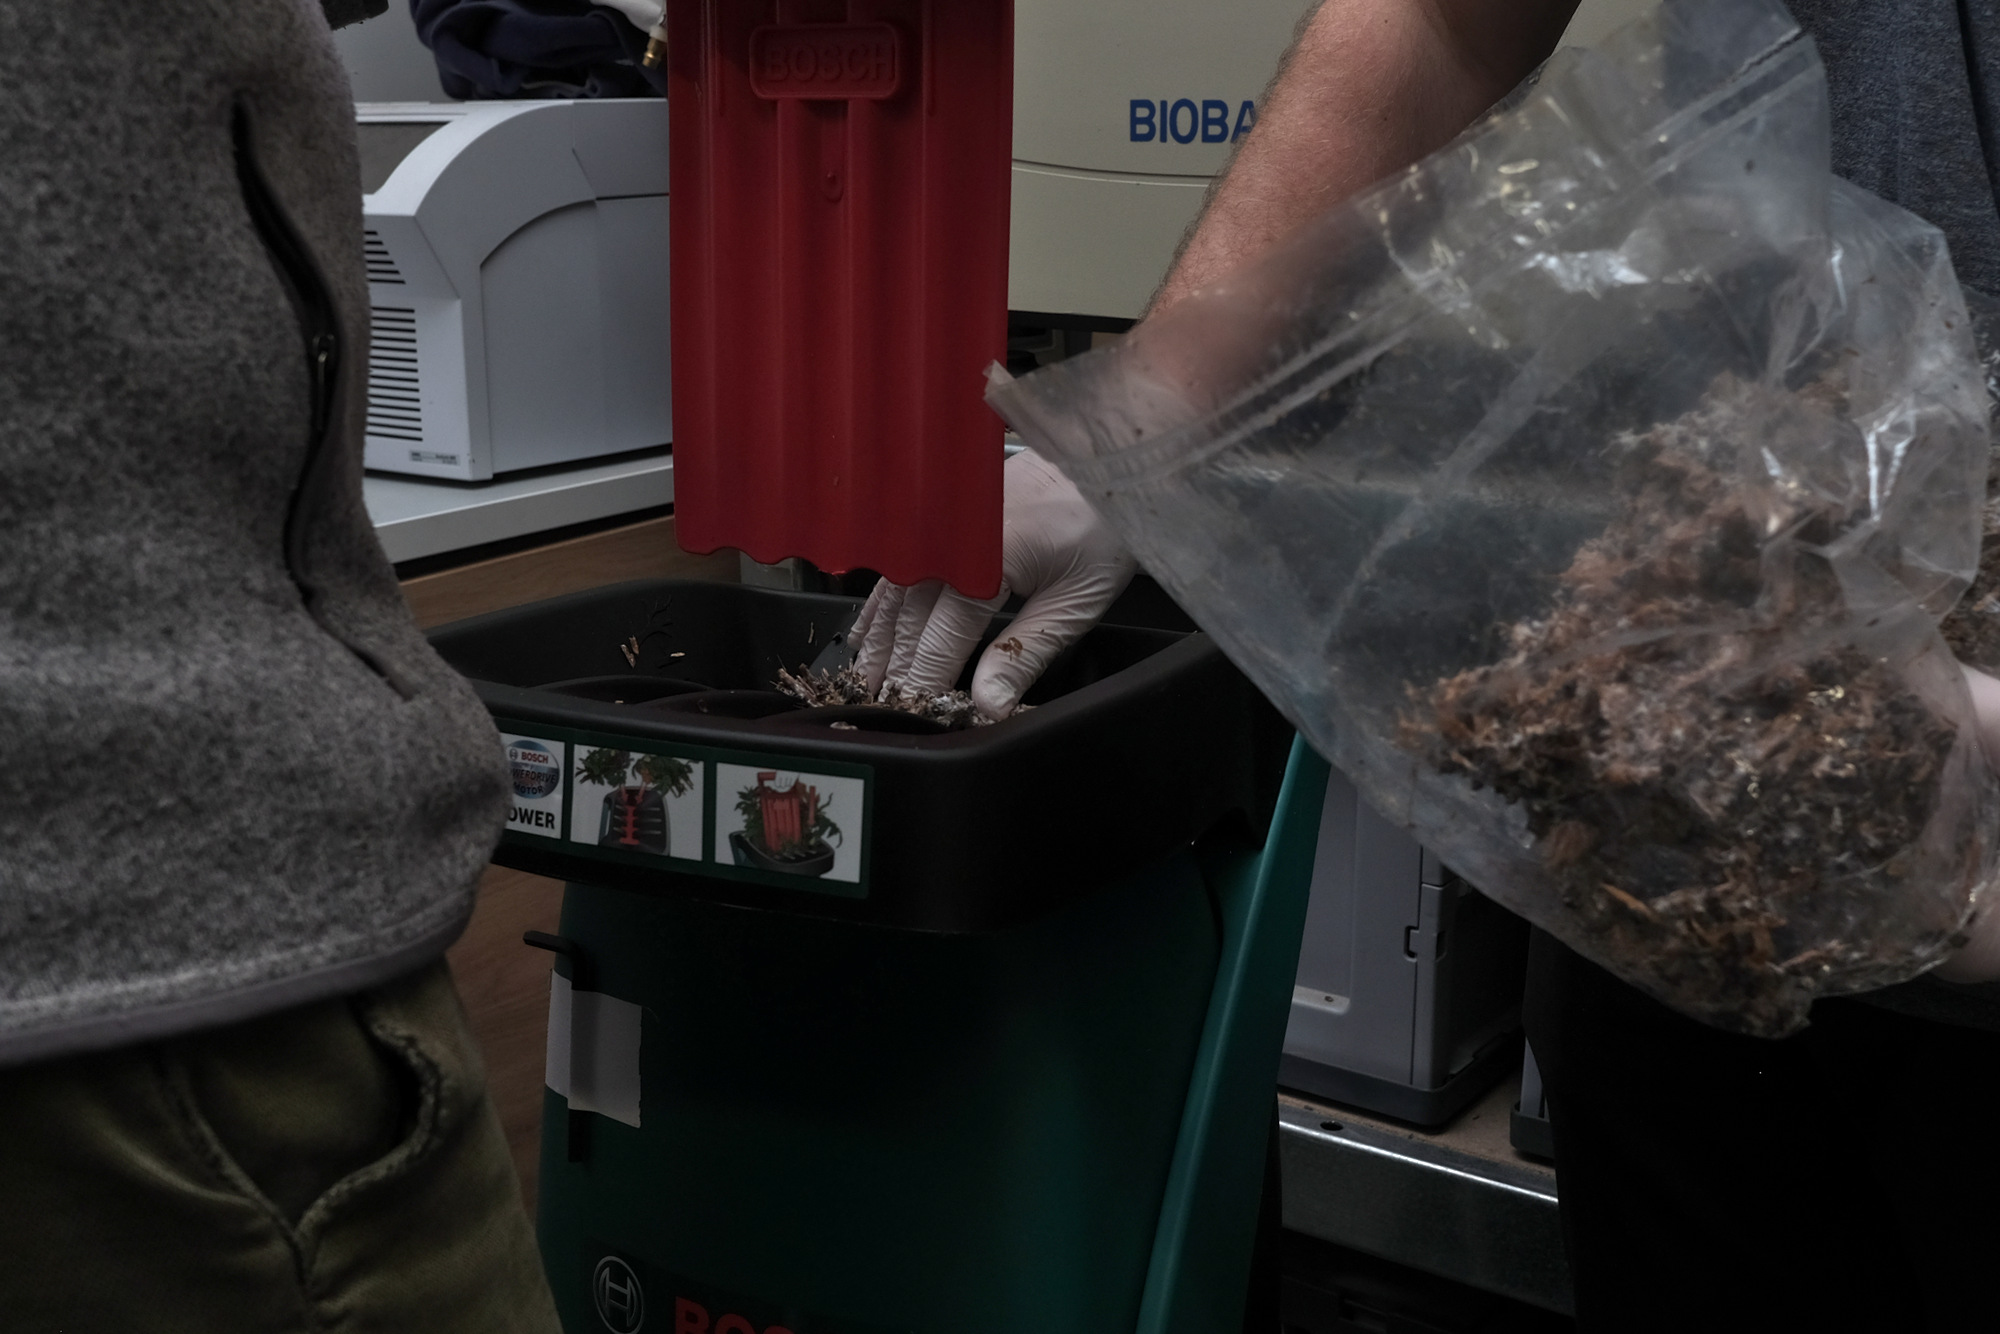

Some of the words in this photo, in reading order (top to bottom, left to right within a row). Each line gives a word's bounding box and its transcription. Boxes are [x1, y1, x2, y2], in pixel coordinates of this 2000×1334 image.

[765, 44, 896, 83] BOSCH
[1130, 98, 1257, 144] BIOBA
[521, 751, 549, 764] BOSCH
[510, 767, 557, 784] WERDRIVE
[508, 807, 555, 830] OWER
